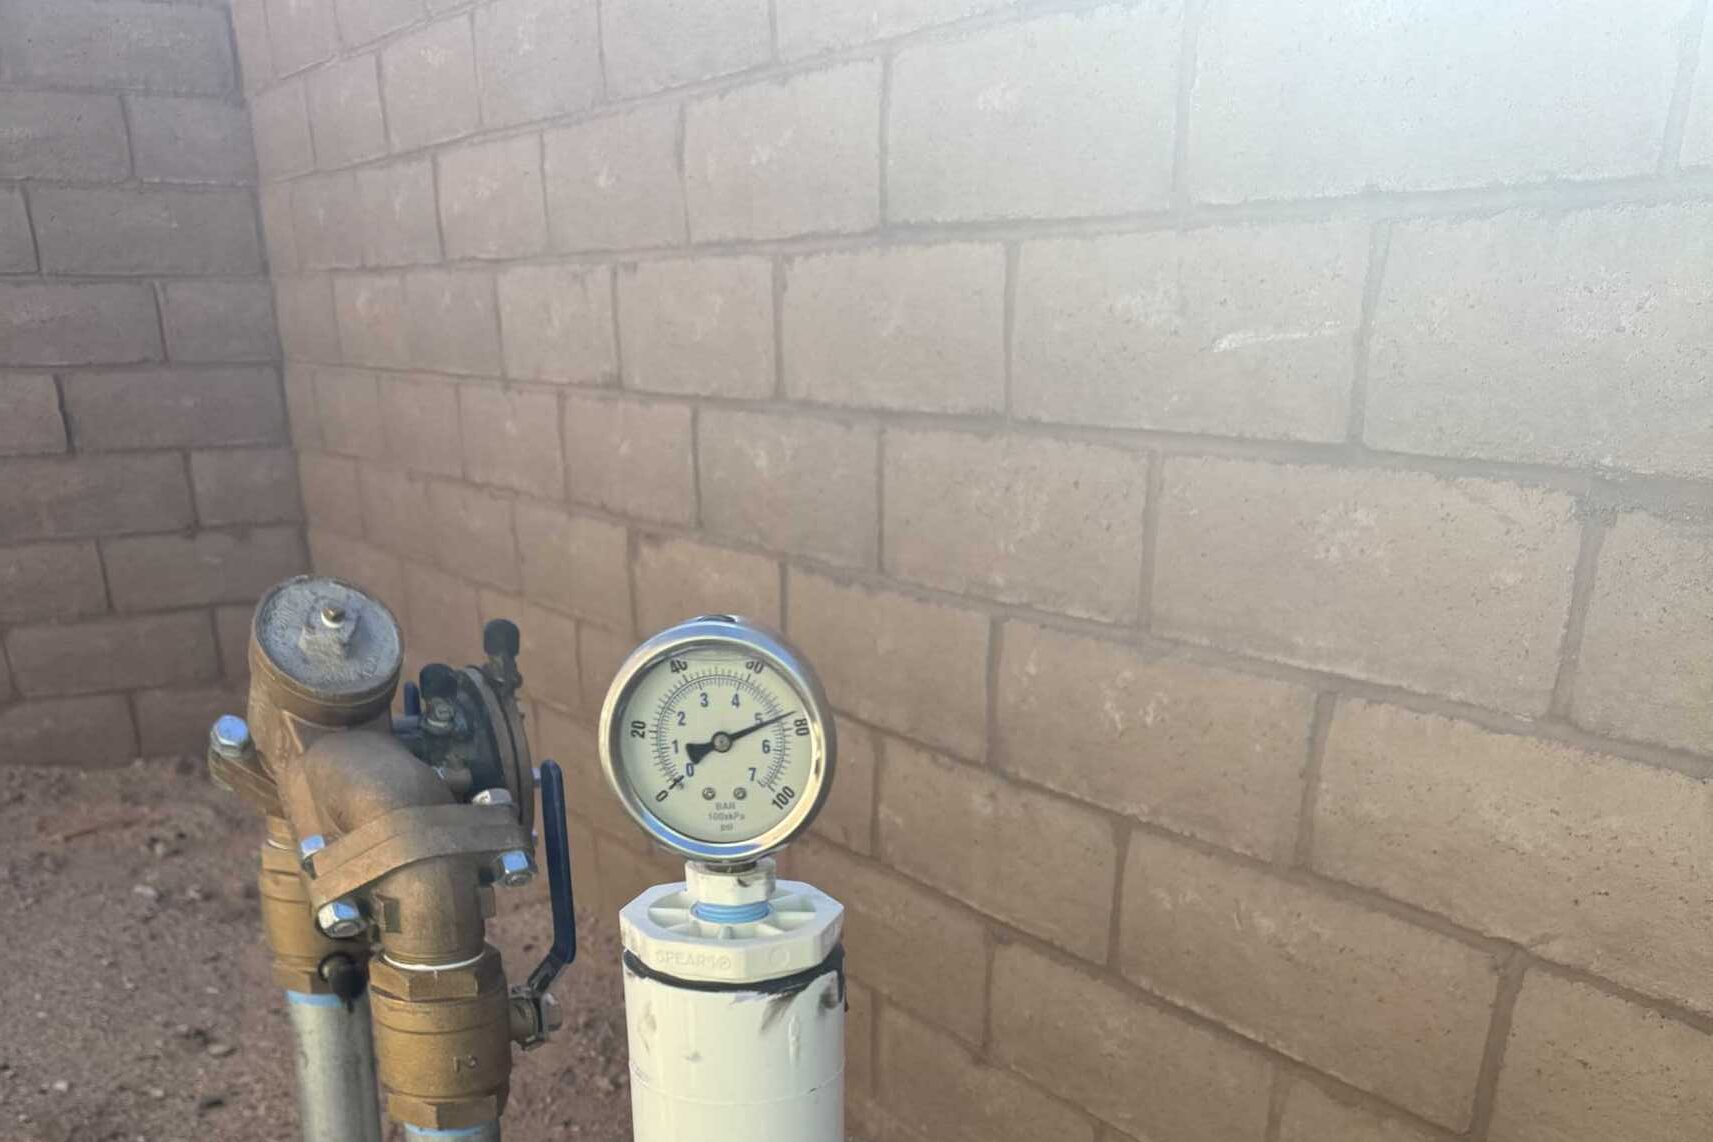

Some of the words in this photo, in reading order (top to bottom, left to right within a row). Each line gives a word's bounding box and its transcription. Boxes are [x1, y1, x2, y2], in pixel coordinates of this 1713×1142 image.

[669, 660, 688, 675] 40
[700, 693, 709, 708] 3
[731, 693, 741, 709] 4
[677, 711, 687, 726] 2
[754, 712, 764, 724] 5
[630, 720, 647, 739] 20
[795, 718, 810, 737] 80
[671, 740, 679, 754] 1
[762, 740, 771, 754] 6
[686, 763, 695, 778] 0
[748, 767, 757, 782] 7
[655, 790, 669, 803] 0
[771, 786, 796, 810] 100
